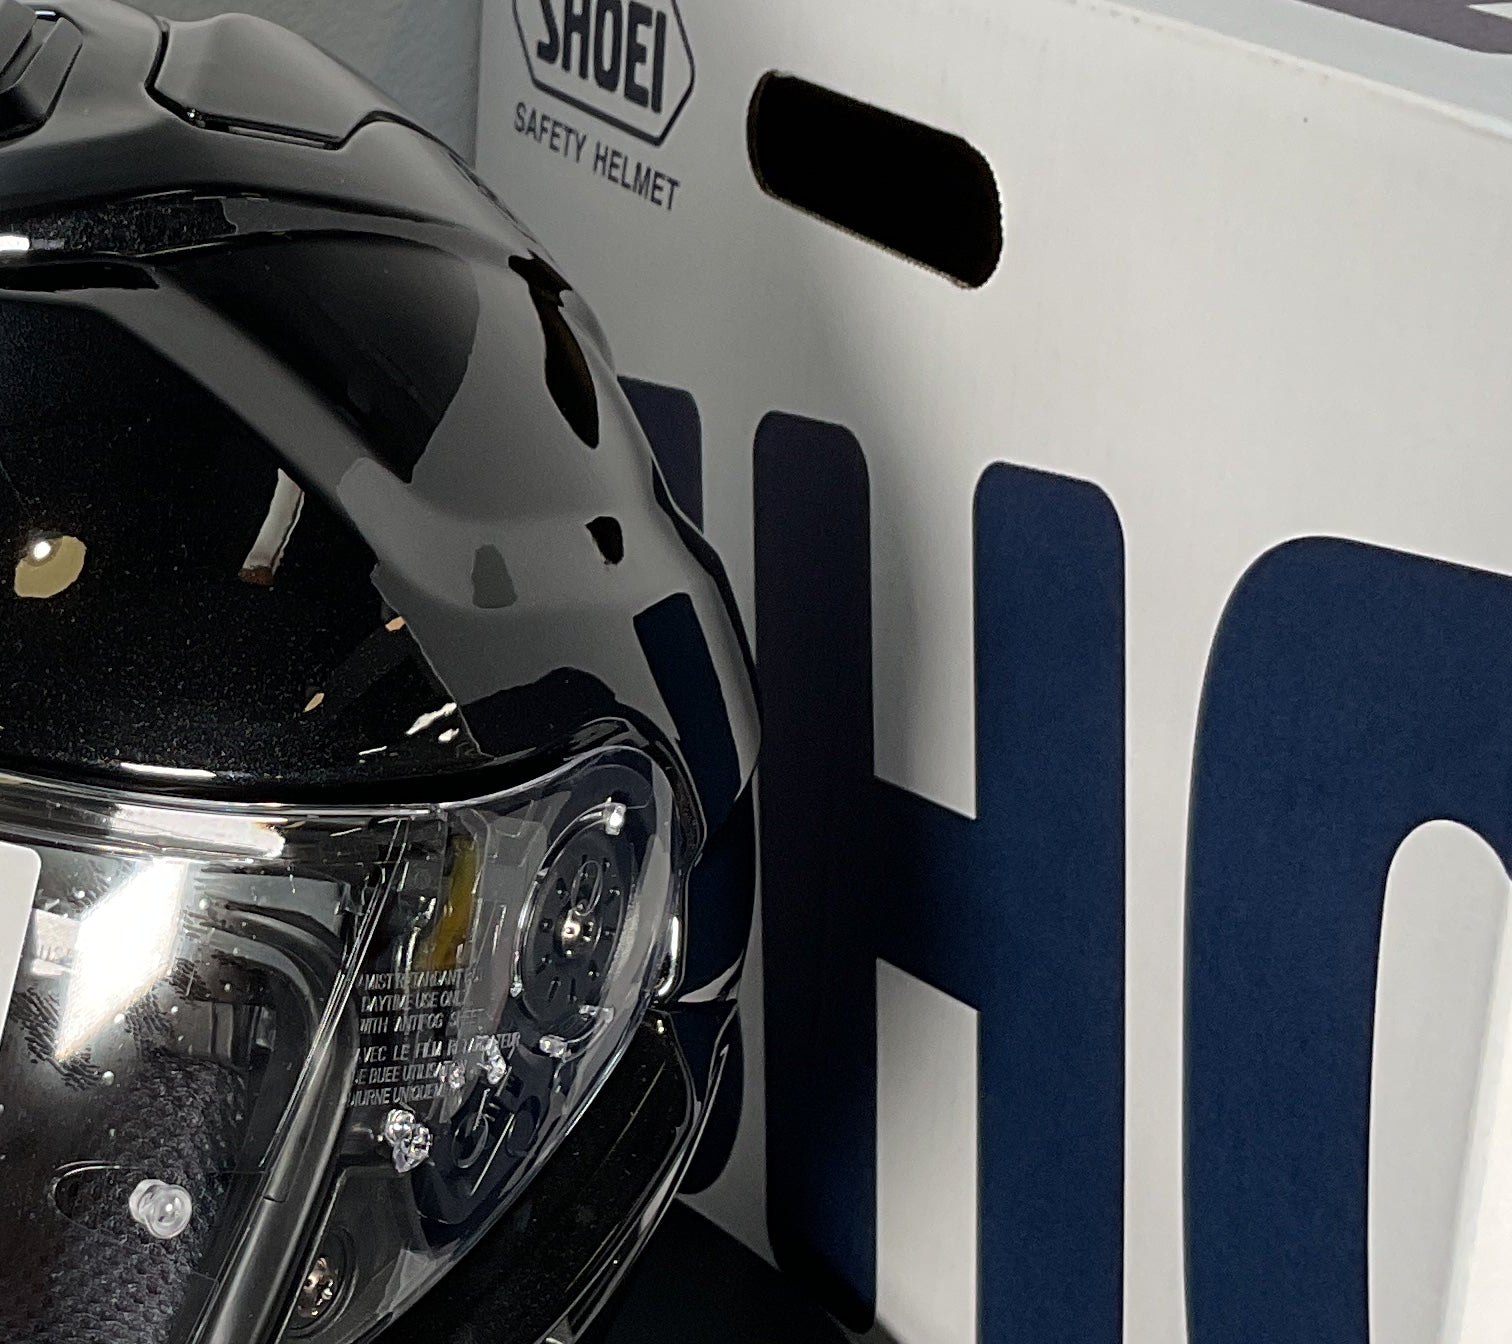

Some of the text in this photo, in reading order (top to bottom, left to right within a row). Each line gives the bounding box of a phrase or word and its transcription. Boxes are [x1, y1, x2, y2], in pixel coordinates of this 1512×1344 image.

[514, 100, 681, 213] SAFETY HELMET
[393, 1044, 410, 1060] LE
